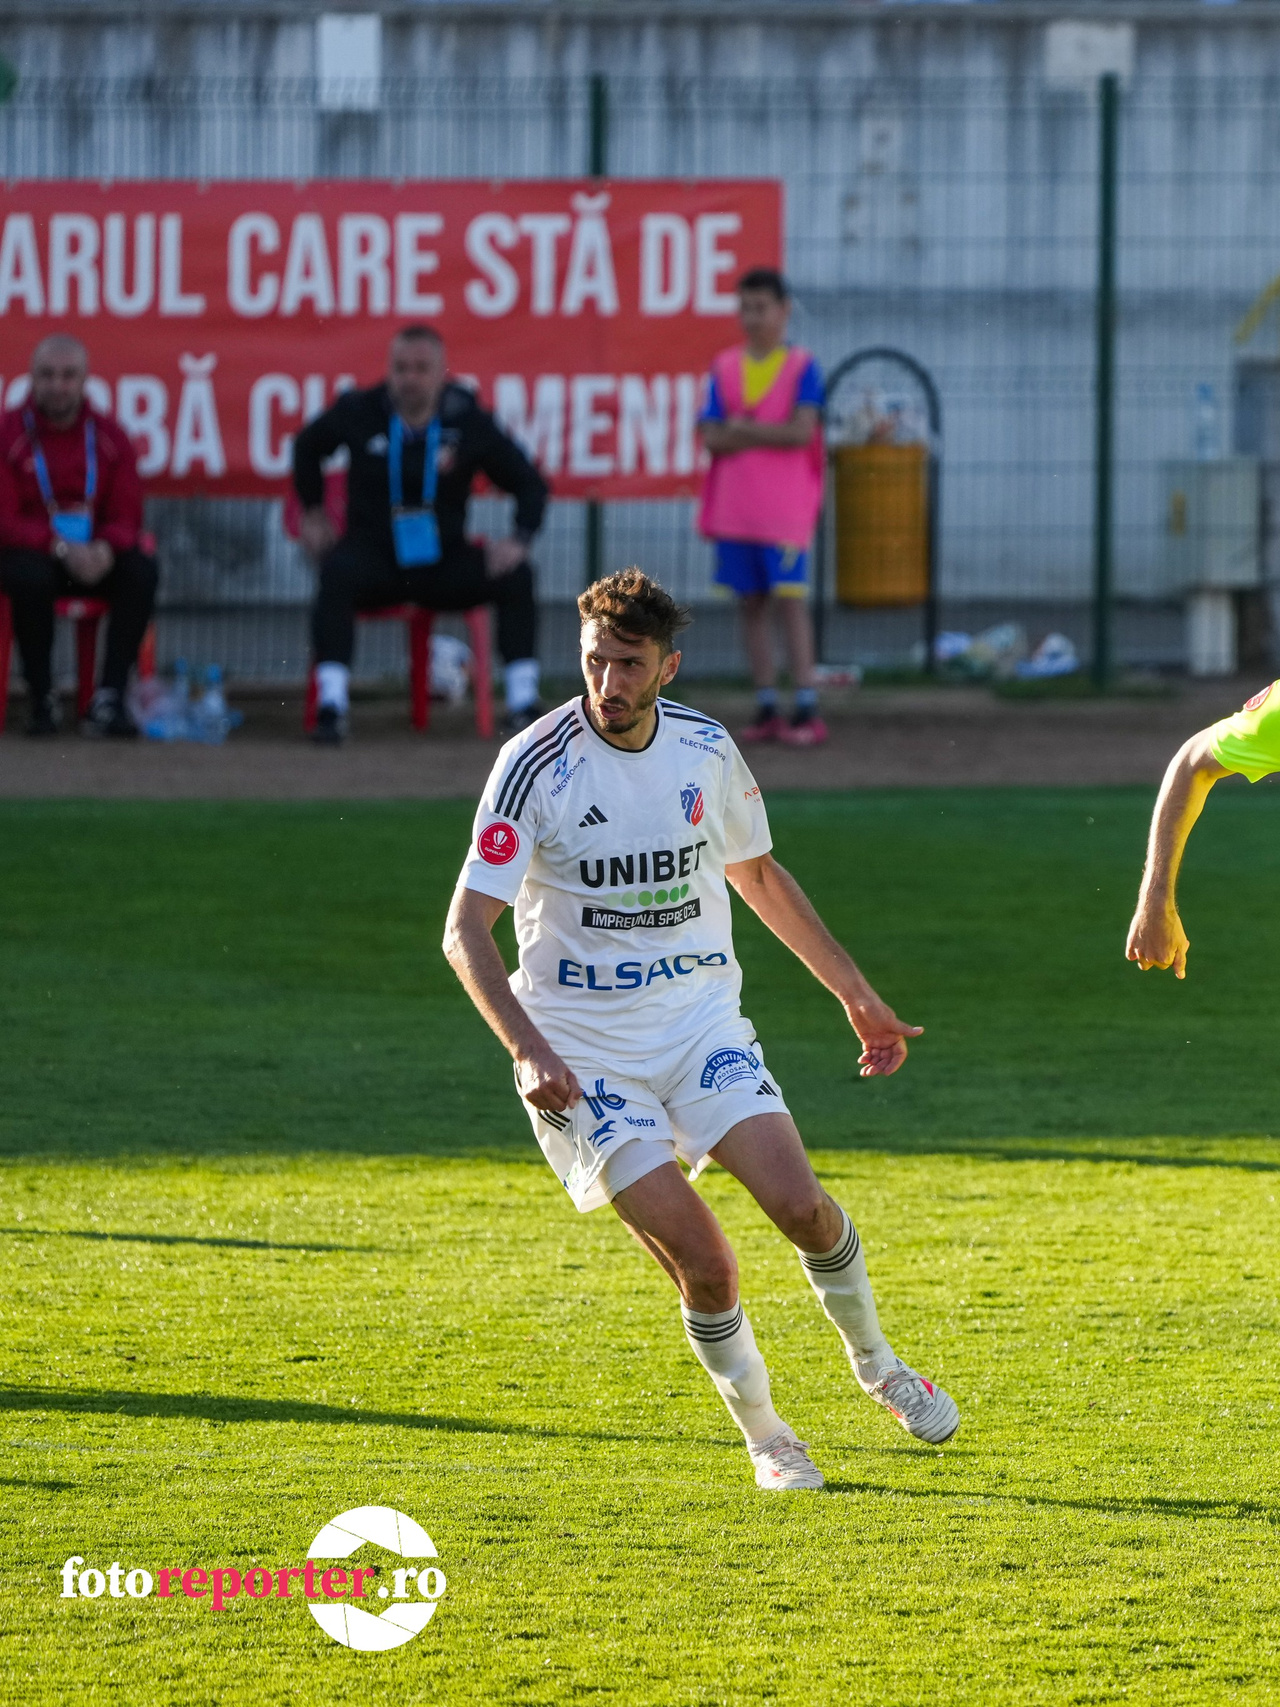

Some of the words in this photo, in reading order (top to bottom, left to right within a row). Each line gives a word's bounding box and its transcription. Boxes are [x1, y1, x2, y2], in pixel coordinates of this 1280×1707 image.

[0, 212, 205, 316] ARUL
[228, 212, 444, 316] CARE
[465, 192, 619, 317] STĂ
[640, 212, 743, 316] DE
[452, 373, 712, 477] MENI
[580, 841, 707, 888] UNIBET
[592, 909, 655, 929] ÎMPREUNĂ
[558, 952, 728, 991] ELSACO
[702, 1066, 715, 1086] FIVE
[712, 1052, 758, 1068] CONTINTS
[580, 1078, 627, 1120] 16
